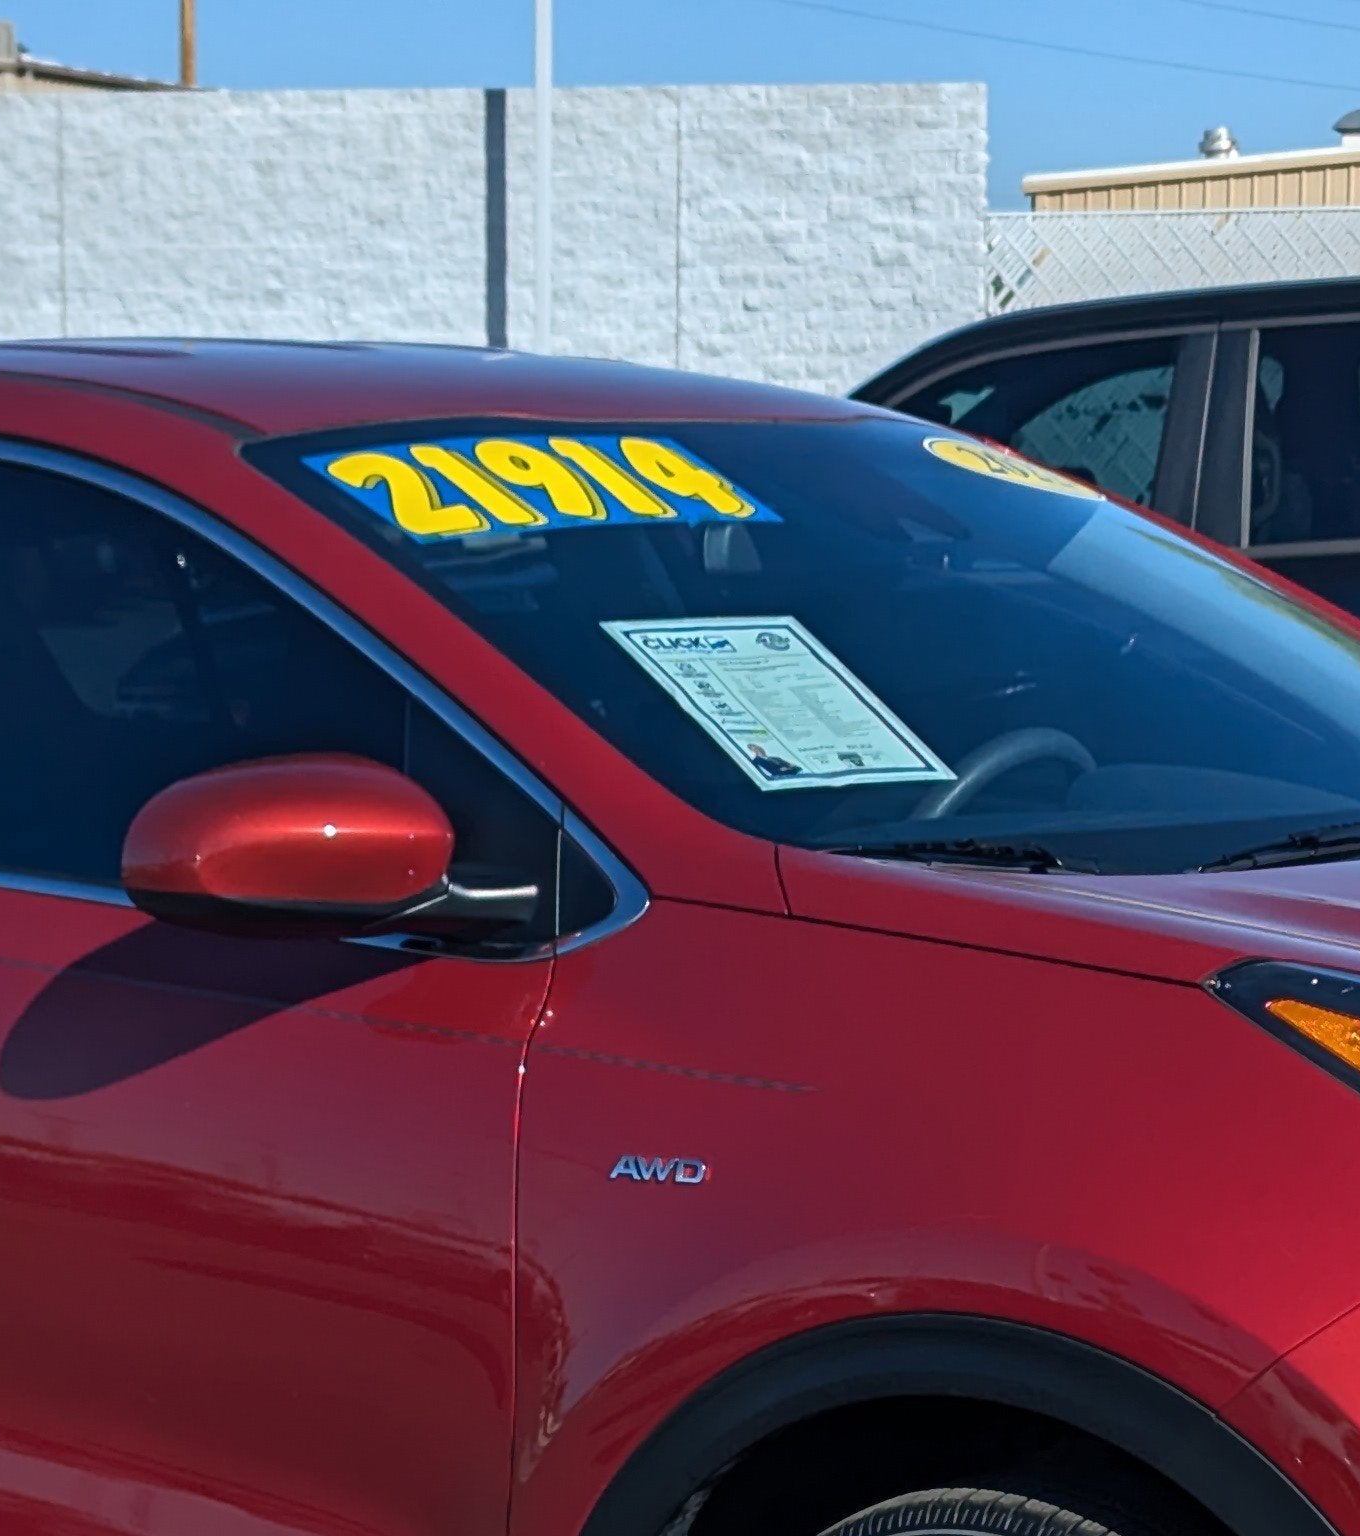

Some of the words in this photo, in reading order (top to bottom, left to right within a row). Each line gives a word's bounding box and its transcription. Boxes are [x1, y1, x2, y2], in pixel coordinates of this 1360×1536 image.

[327, 436, 756, 536] 21914
[642, 636, 707, 650] CLICK
[609, 1153, 707, 1184] AWD
